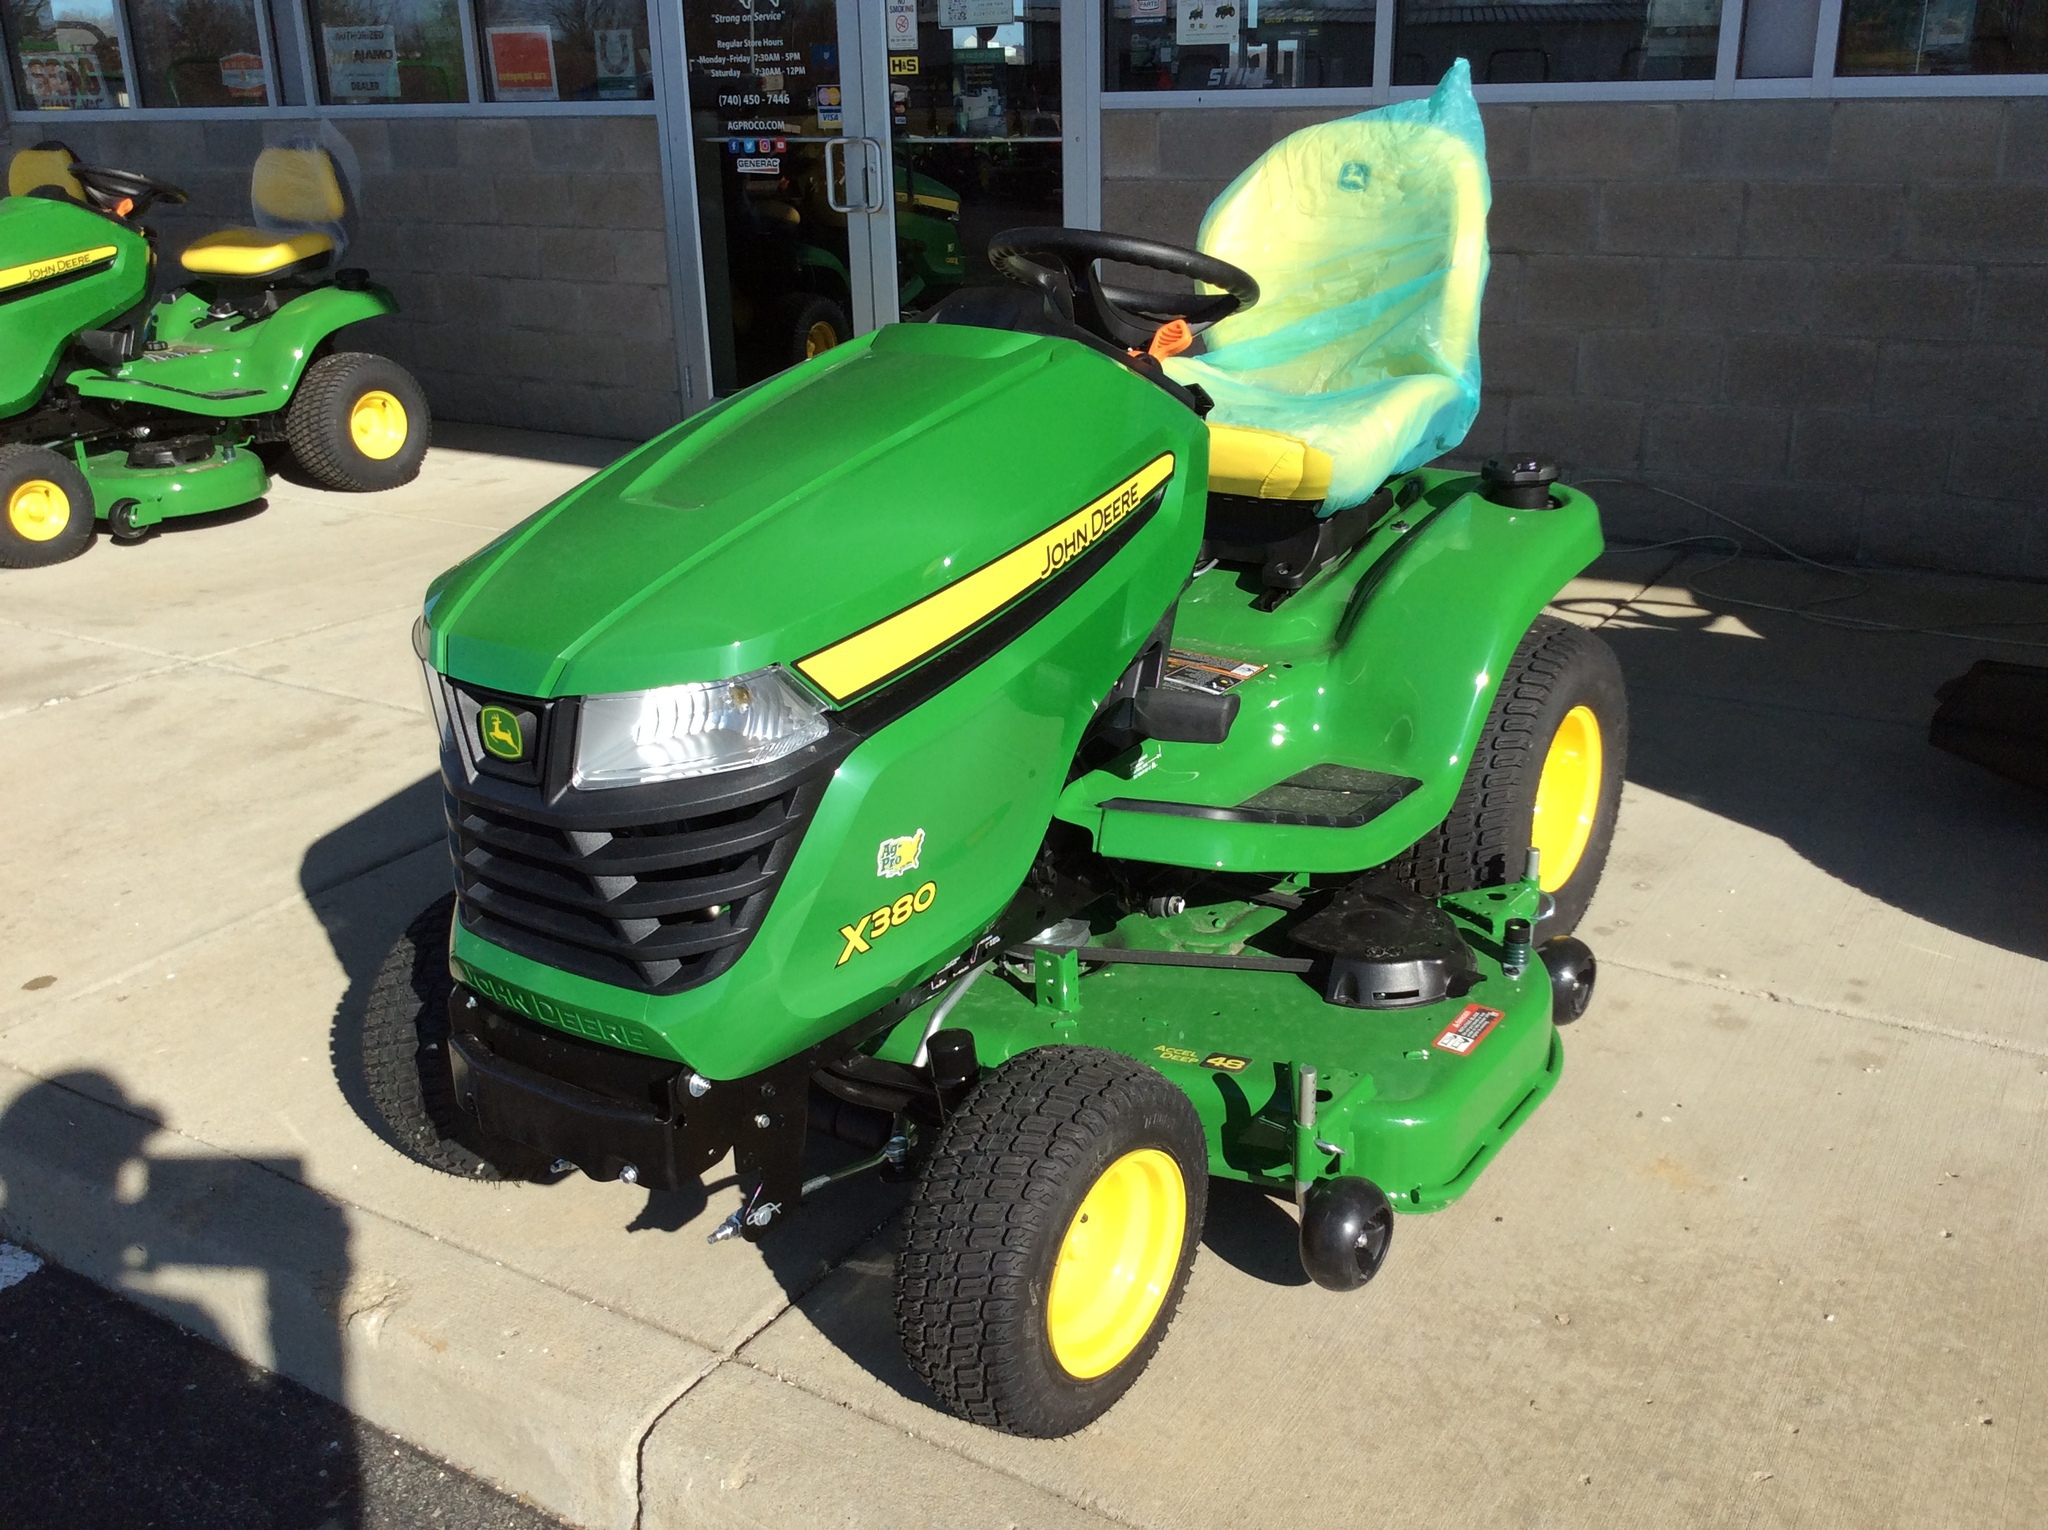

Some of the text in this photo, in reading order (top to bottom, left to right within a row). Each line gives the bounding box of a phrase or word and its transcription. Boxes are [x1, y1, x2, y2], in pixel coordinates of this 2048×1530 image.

[889, 4, 914, 13] SMOKING
[742, 14, 752, 22] on
[717, 38, 784, 50] Regular Store Hours
[754, 53, 780, 62] 7:30AM
[785, 52, 801, 61] 5PM
[711, 69, 741, 78] Saturday
[755, 67, 781, 76] 7:30AM
[786, 66, 806, 75] 12PM
[891, 59, 917, 73] H&S
[1207, 67, 1273, 86] STIHL
[351, 81, 380, 91] DEALER
[718, 94, 742, 107] (740)
[743, 94, 760, 105] 450
[766, 93, 790, 105] 7446
[822, 113, 839, 121] VISA
[727, 120, 785, 131] AGPROCO.COM
[738, 159, 778, 168] GENERAC
[27, 253, 91, 281] JOHN DEERE
[1041, 482, 1140, 576] JOHN DEERE
[880, 855, 902, 872] Pro
[834, 880, 938, 969] X380
[462, 964, 650, 1051] JOHN DEERE
[1153, 1044, 1198, 1058] ACCEL
[1159, 1052, 1200, 1064] DEEP
[1206, 1056, 1246, 1070] 48
